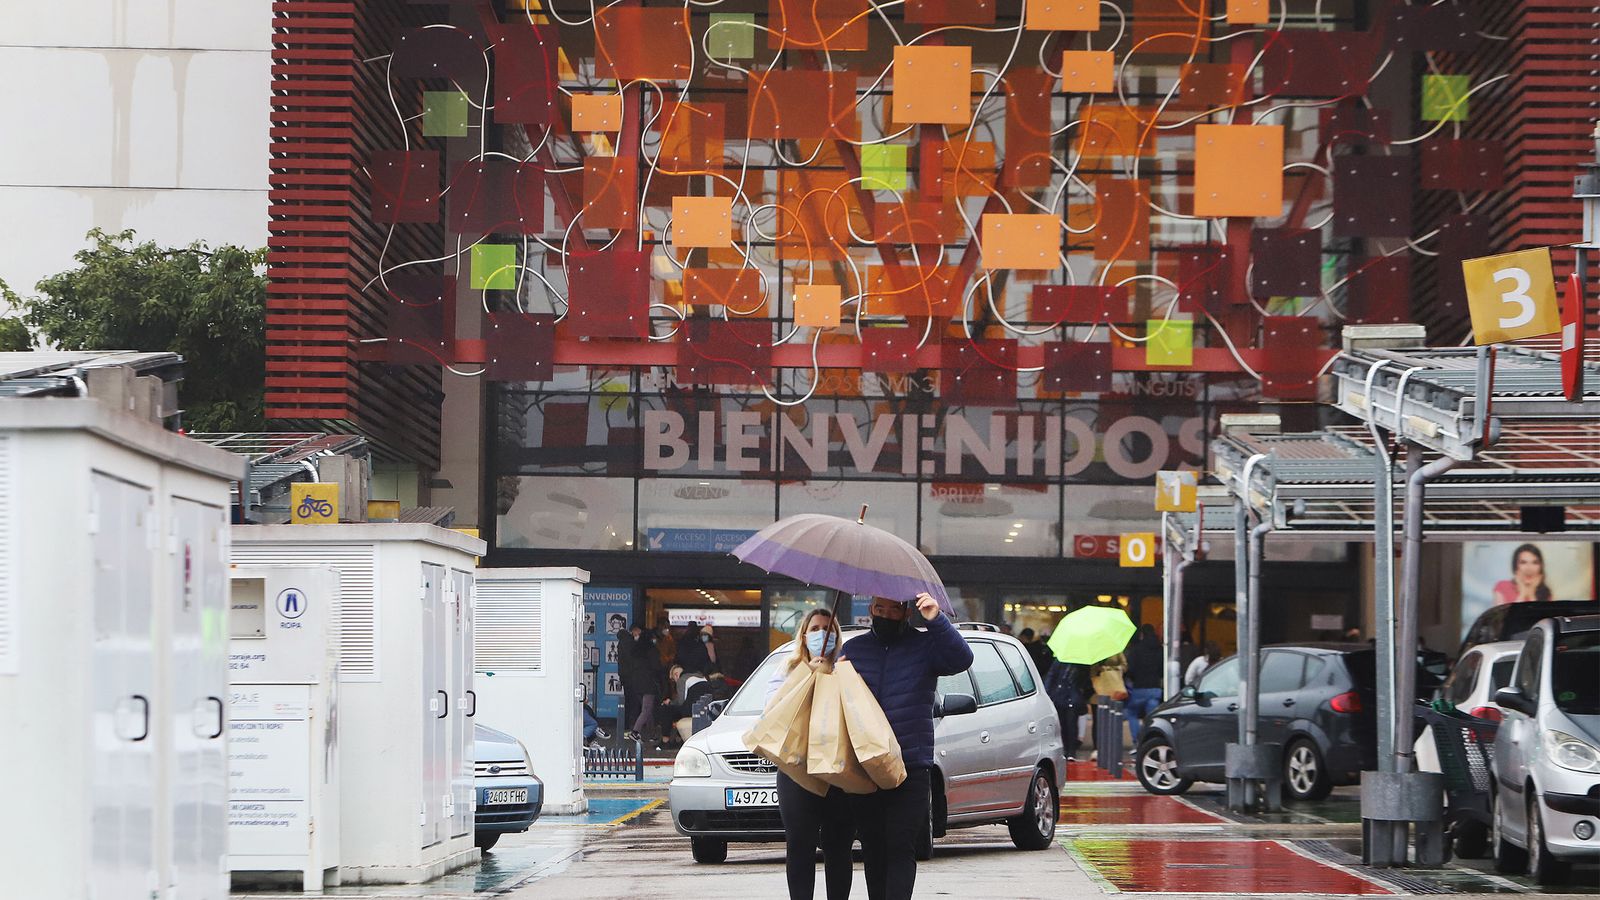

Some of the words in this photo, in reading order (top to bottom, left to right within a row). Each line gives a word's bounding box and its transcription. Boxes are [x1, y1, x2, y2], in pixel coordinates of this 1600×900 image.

[1493, 267, 1536, 329] 3
[643, 410, 1215, 480] BIENVENIDOS
[1170, 476, 1181, 506] 1
[584, 592, 631, 601] ENVENIDO!
[510, 790, 526, 803] FHC
[734, 791, 768, 804] 4972
